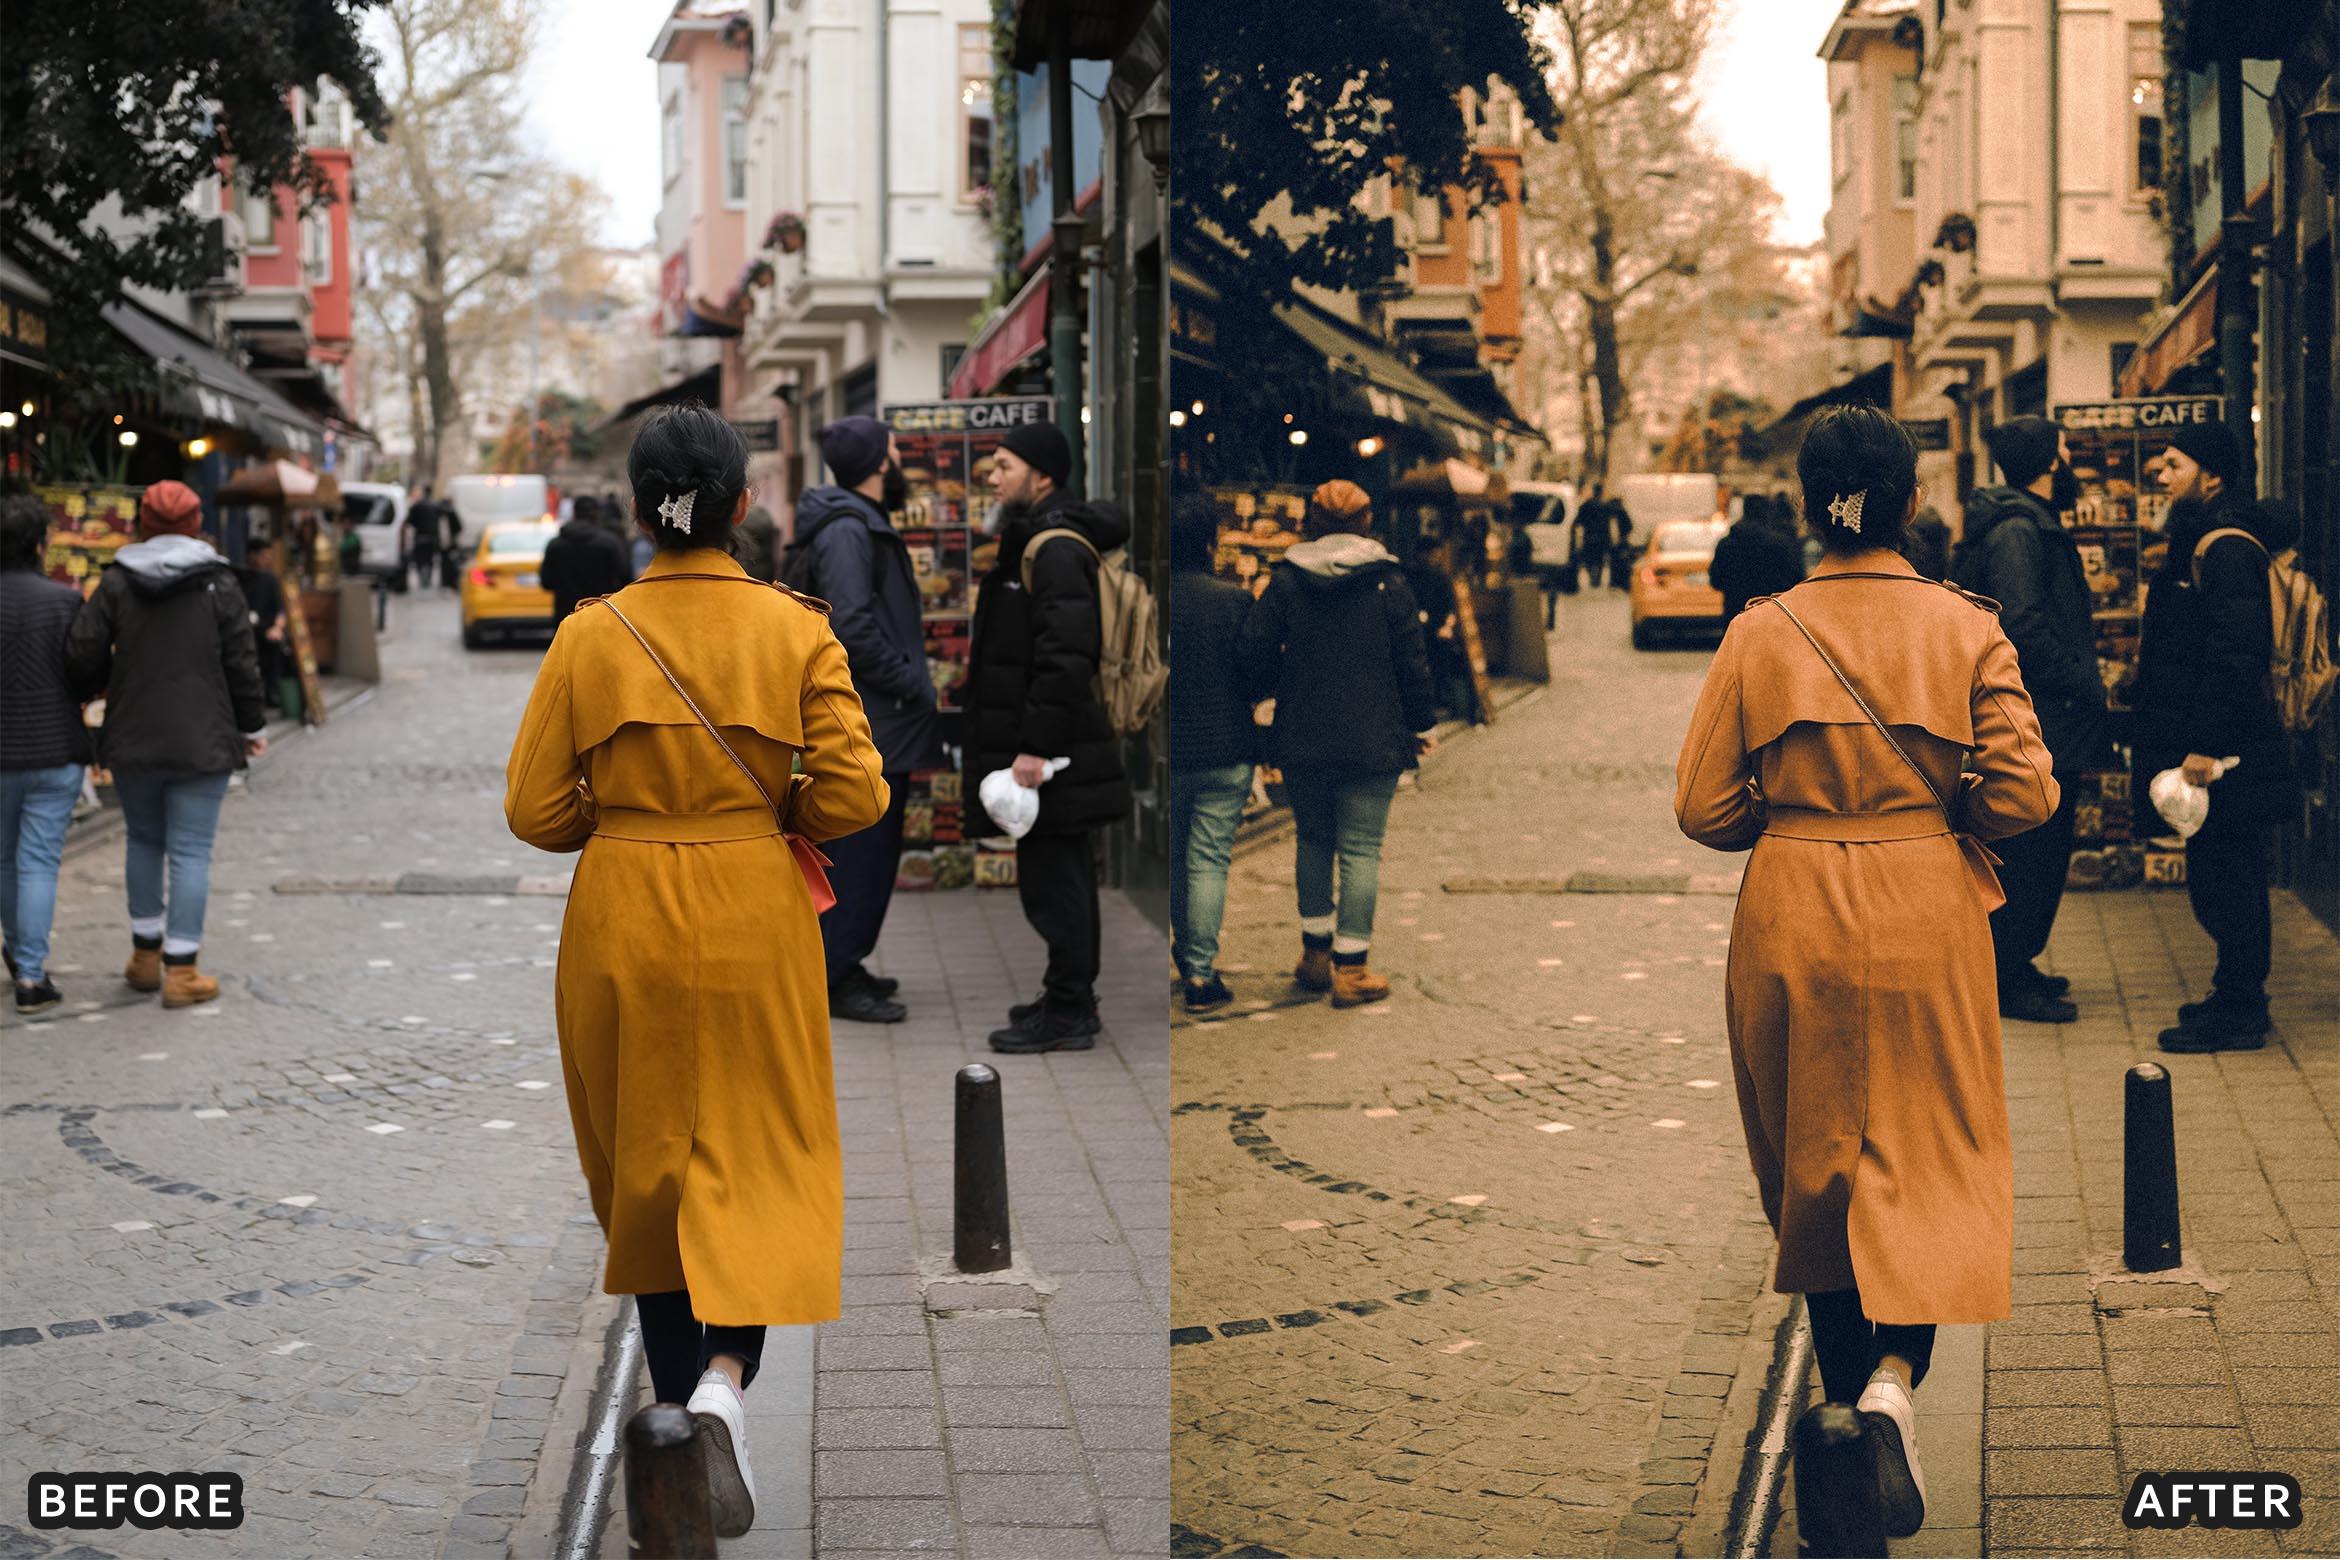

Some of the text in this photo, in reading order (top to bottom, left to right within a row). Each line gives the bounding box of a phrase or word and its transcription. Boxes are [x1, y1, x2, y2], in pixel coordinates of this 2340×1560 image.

[970, 402, 1038, 427] CAFE
[2140, 402, 2208, 427] CAFE
[982, 858, 1013, 879] 50
